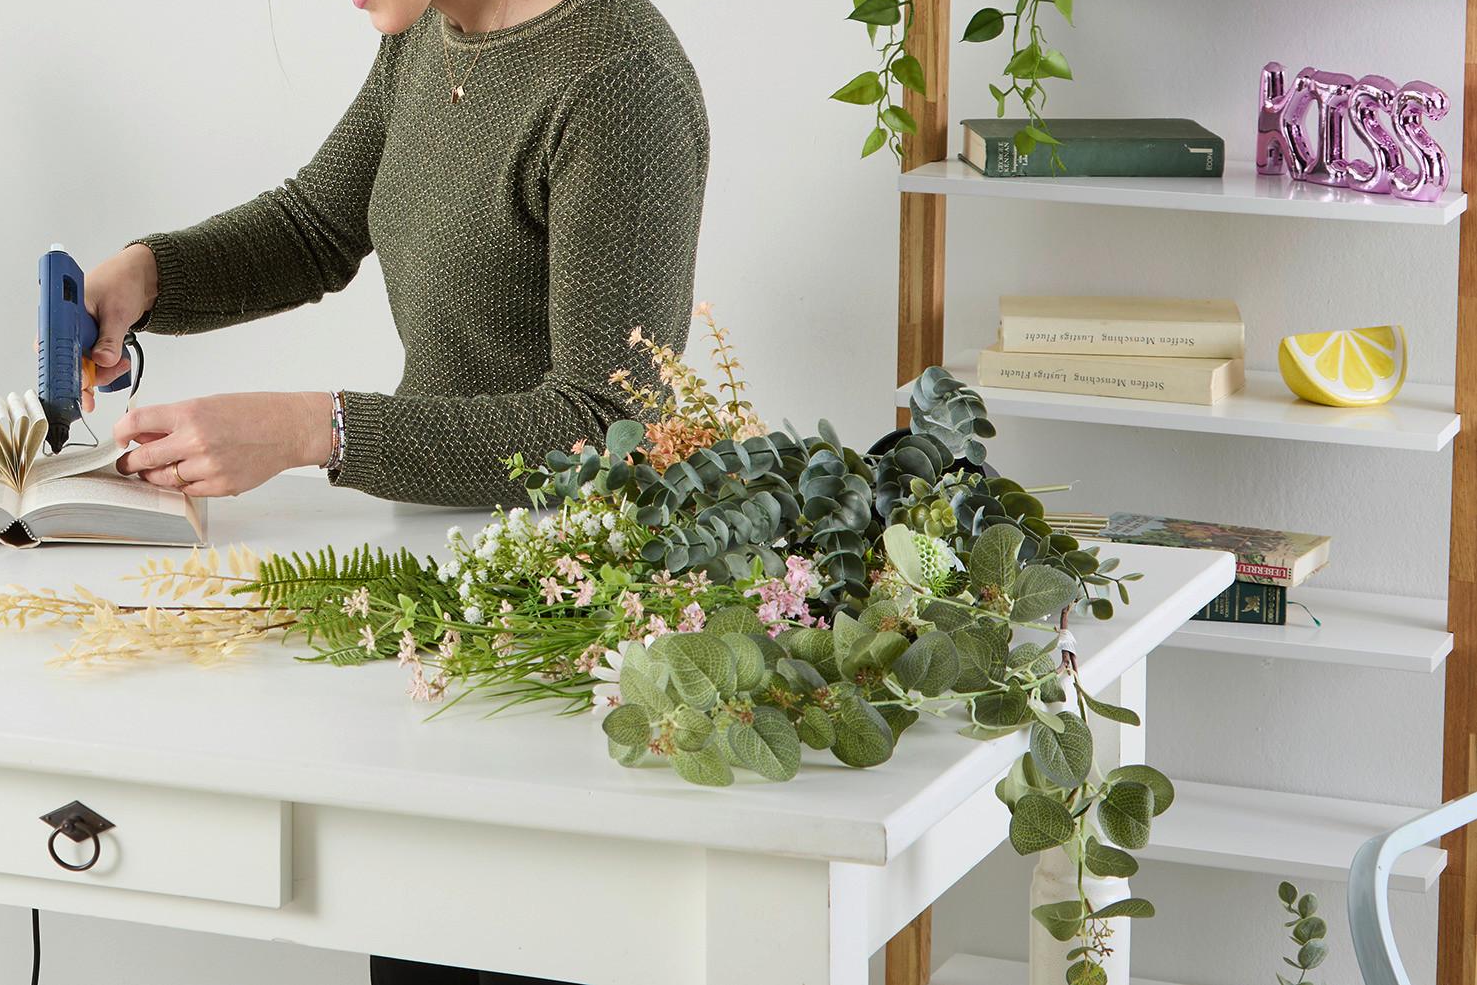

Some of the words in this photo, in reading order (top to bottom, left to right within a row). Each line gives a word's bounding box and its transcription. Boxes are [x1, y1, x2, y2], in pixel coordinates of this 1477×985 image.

[1256, 61, 1452, 202] KISS
[1025, 333, 1057, 343] Flucht
[1060, 332, 1094, 343] Lustigs
[1101, 333, 1155, 345] Mensching
[1159, 337, 1195, 347] Steffen
[1000, 368, 1031, 379] Flucht
[1033, 370, 1067, 383] Lustigs
[1074, 373, 1126, 387] Mensching
[1130, 380, 1165, 391] Steffen
[1237, 564, 1286, 577] UEBERREU
